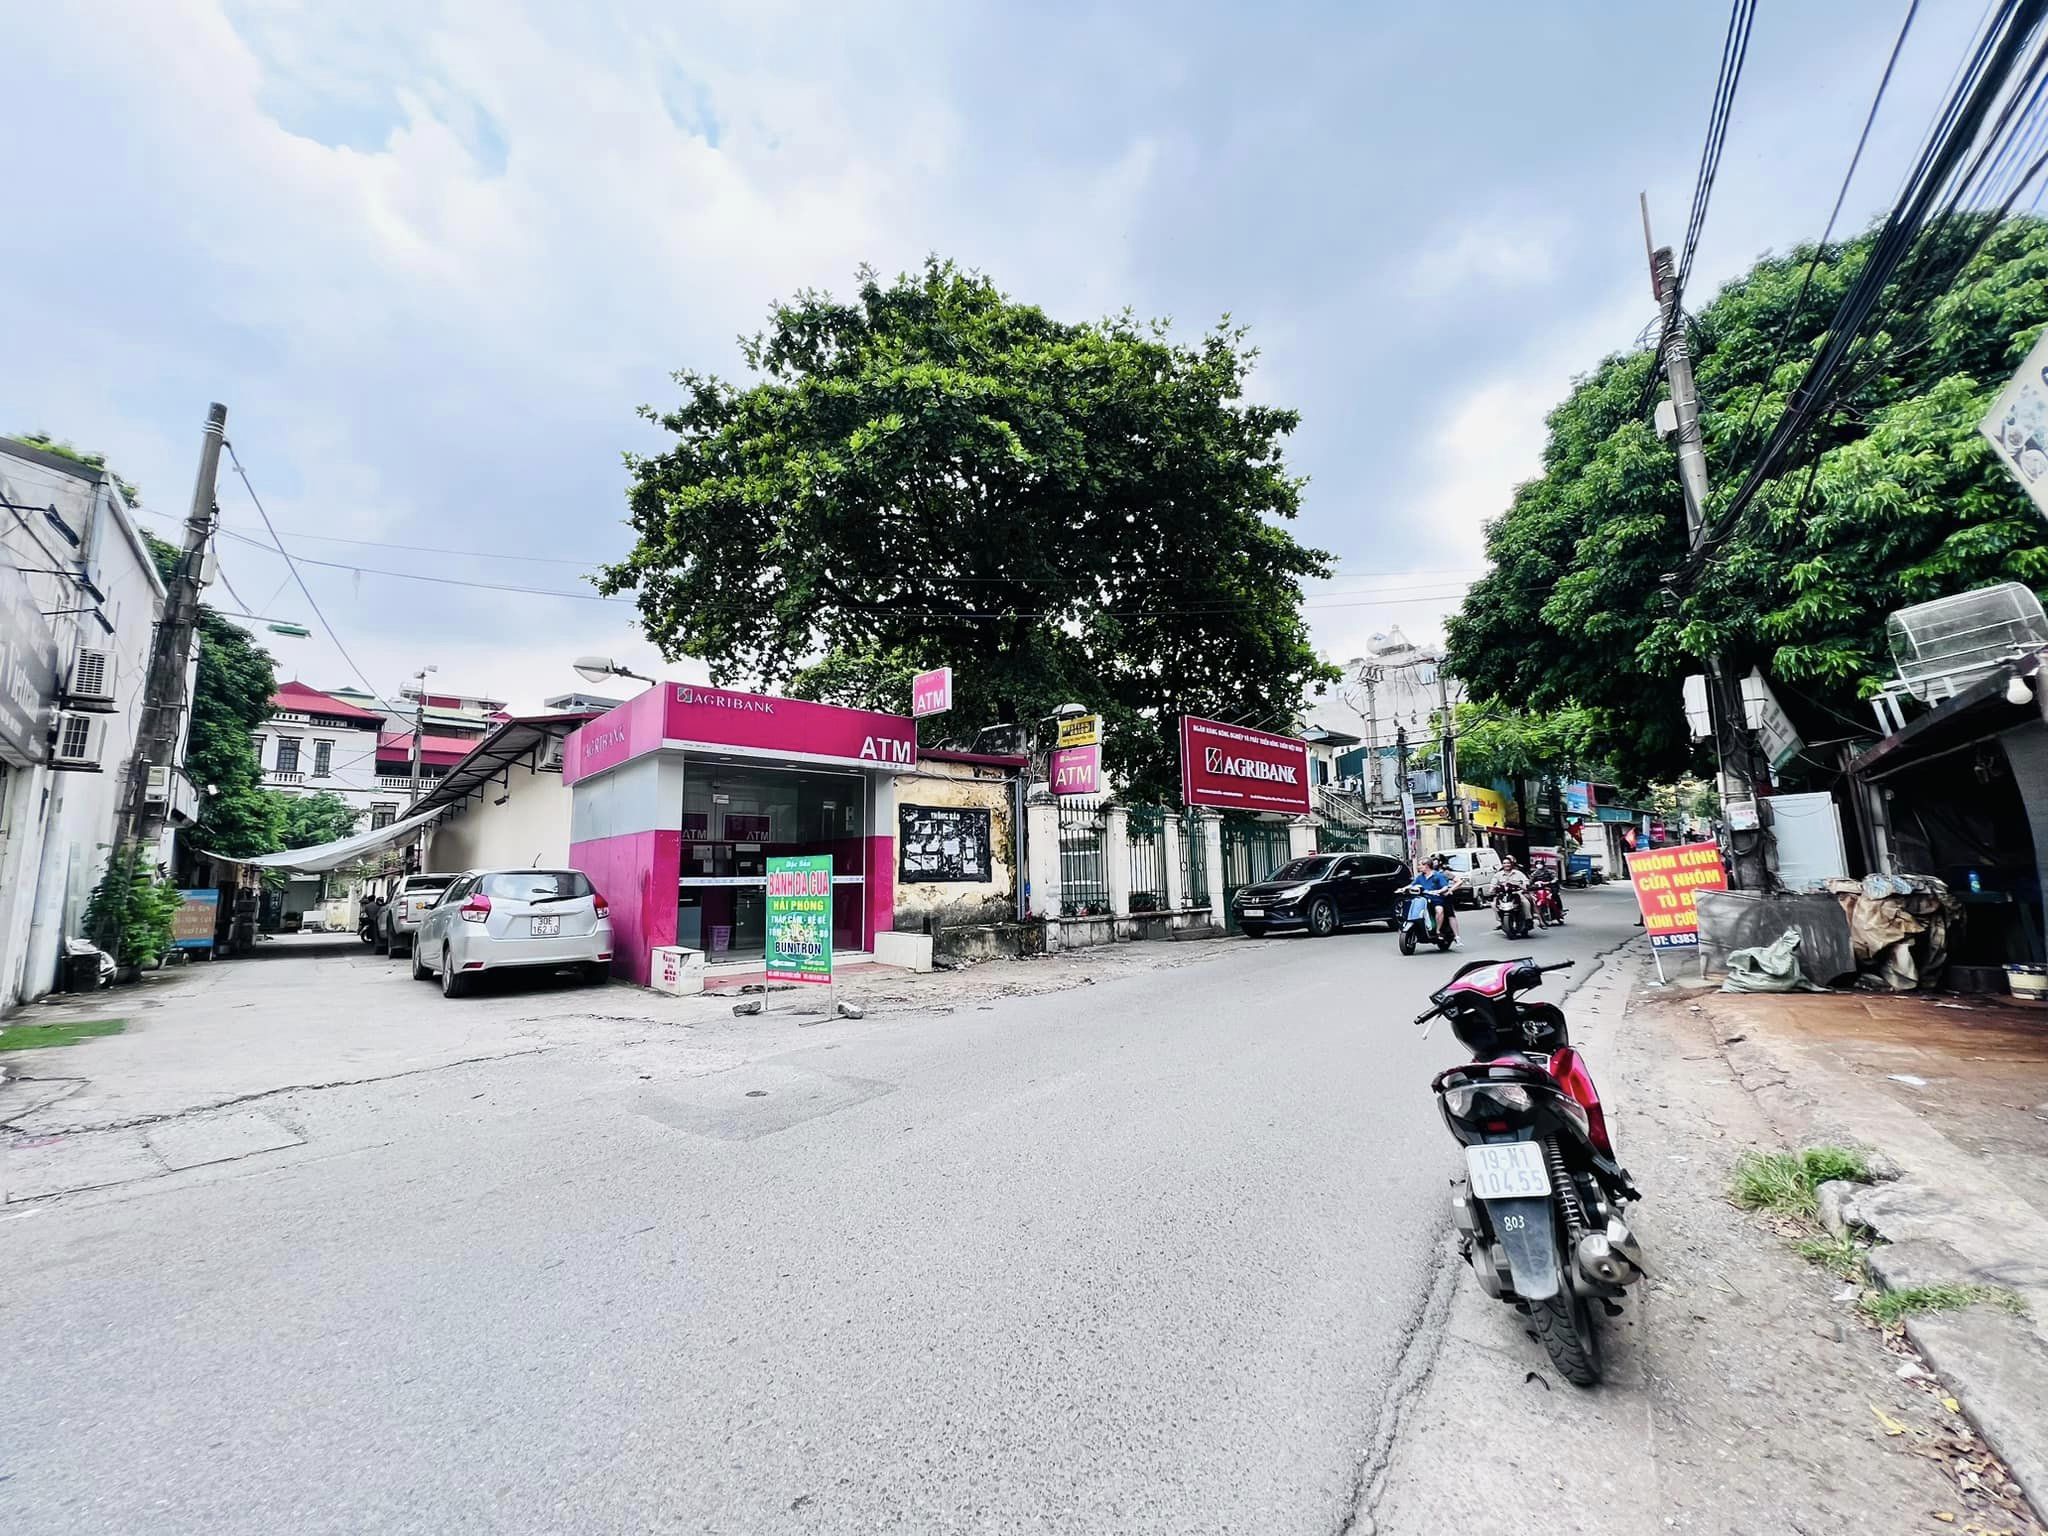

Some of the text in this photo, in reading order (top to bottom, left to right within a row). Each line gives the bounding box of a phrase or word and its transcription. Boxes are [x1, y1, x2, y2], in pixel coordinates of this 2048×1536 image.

[694, 693, 776, 714] AGRIBANK
[916, 689, 945, 713] ATM
[585, 724, 625, 760] AGRIBANK
[860, 736, 911, 763] ATM
[1056, 765, 1092, 787] ATM
[1224, 756, 1298, 785] AGRIBANK
[682, 829, 707, 841] ATM
[746, 831, 769, 841] ATM
[1631, 849, 1718, 873] NHÔM KÍNH
[768, 867, 794, 897] BÁNH
[809, 870, 829, 896] CUA
[1672, 869, 1721, 887] NHÔM
[1646, 913, 1673, 929] KÍNH
[1479, 1147, 1530, 1170] 19-N1
[1503, 1215, 1526, 1231] 803
